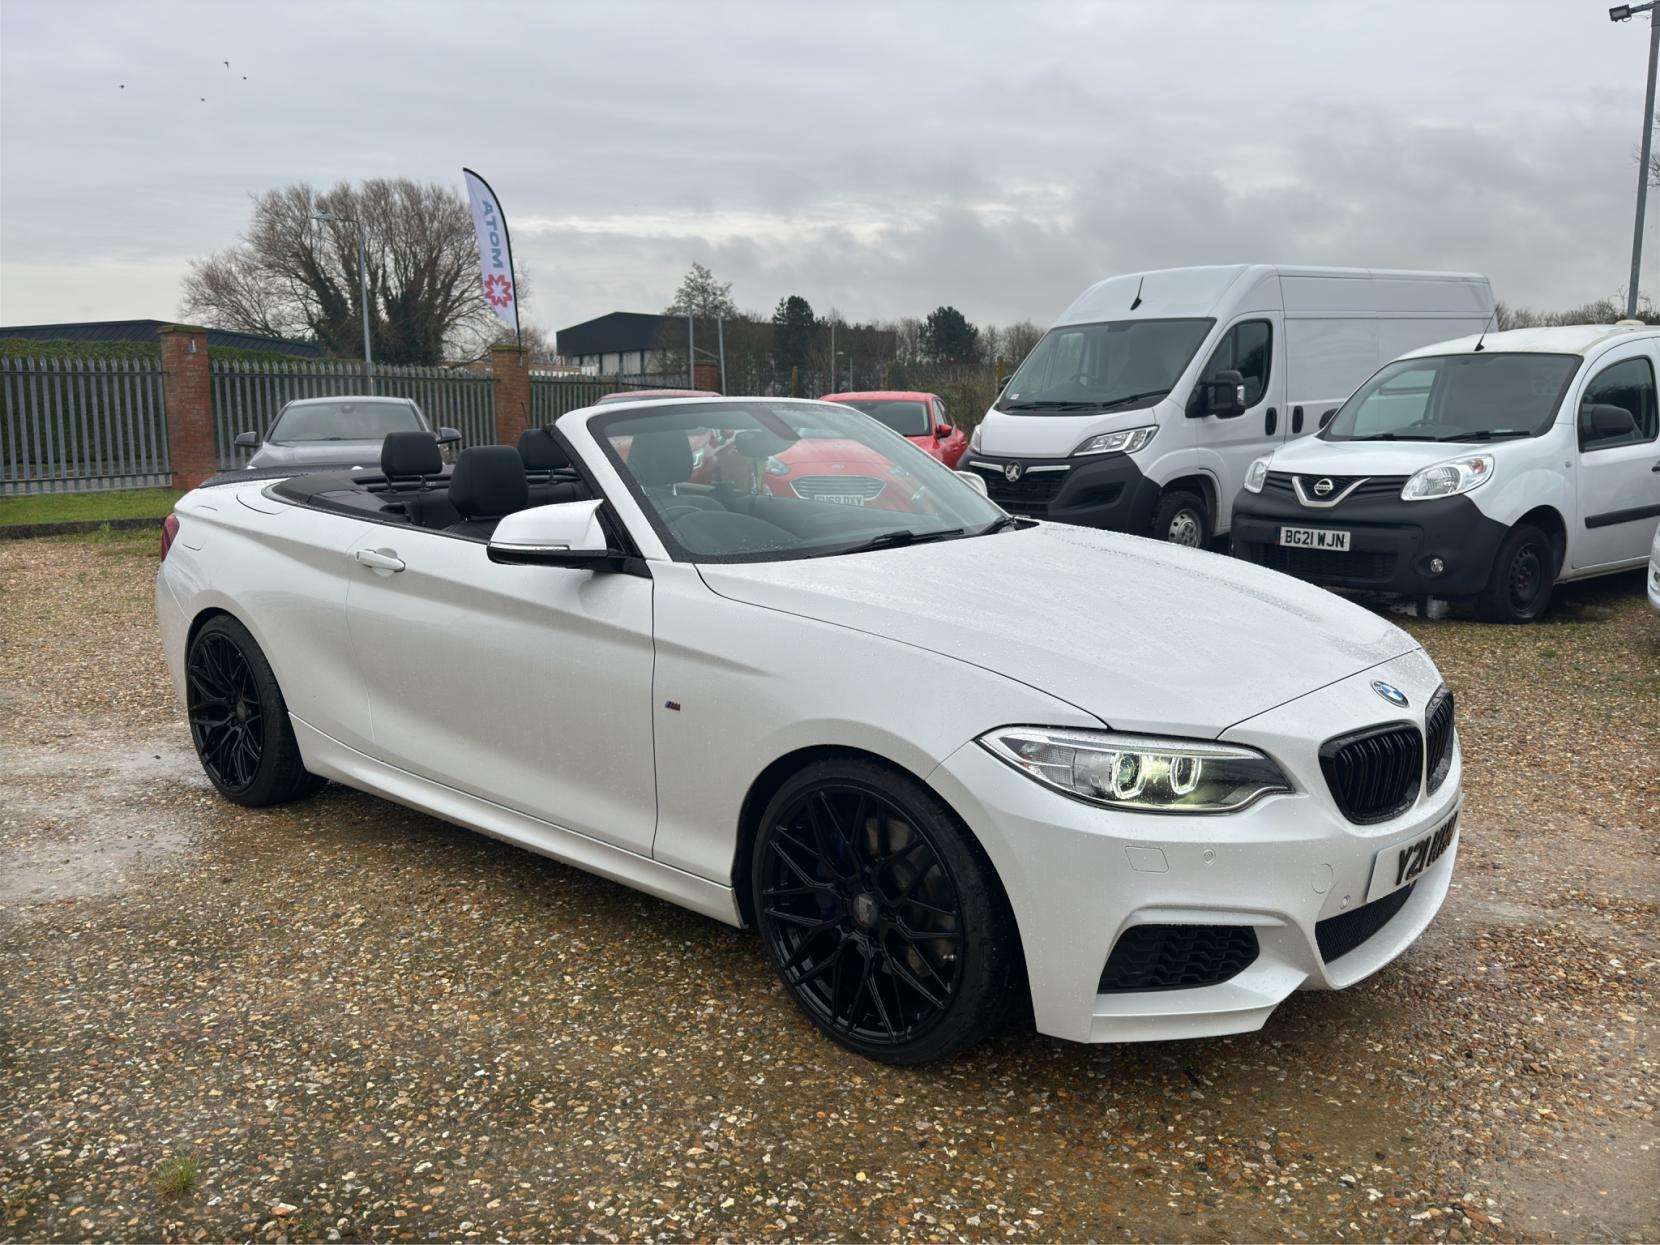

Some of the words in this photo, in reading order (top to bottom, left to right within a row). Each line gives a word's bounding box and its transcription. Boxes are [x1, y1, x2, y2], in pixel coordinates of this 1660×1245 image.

[483, 199, 503, 268] ATOM
[1285, 530, 1314, 545] BG21
[1317, 532, 1345, 548] WJN
